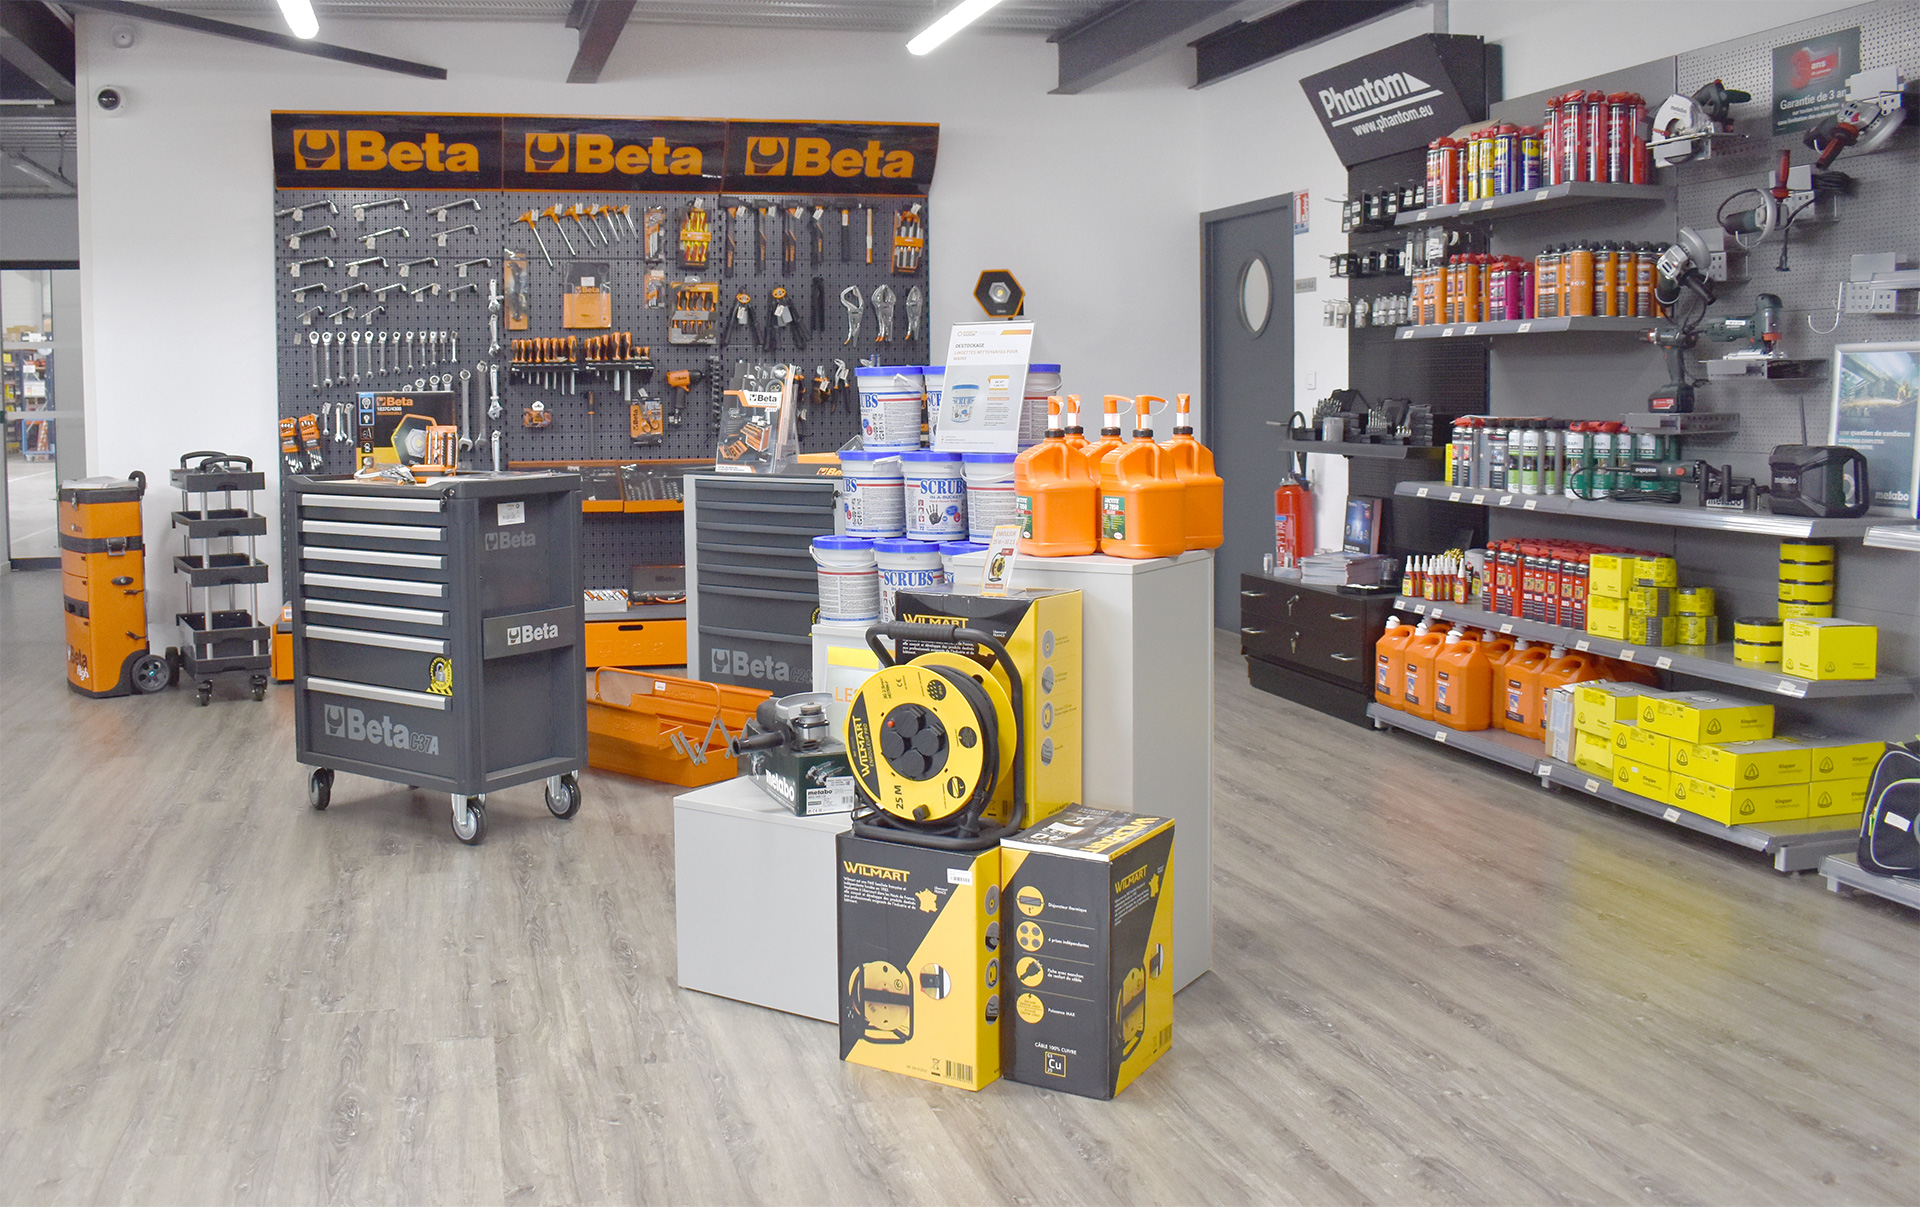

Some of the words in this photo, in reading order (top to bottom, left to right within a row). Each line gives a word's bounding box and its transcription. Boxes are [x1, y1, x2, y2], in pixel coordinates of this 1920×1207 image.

[1811, 60, 1826, 70] ans
[1318, 72, 1408, 119] Phantom
[1780, 94, 1815, 110] Garantie
[1816, 92, 1828, 102] de
[1829, 90, 1835, 100] 3
[1836, 88, 1847, 98] an
[1352, 105, 1434, 136] www.phantom.eu
[346, 130, 479, 172] Beta
[576, 134, 703, 175] Beta
[792, 137, 914, 178] Beta
[387, 396, 414, 406] Beta
[758, 394, 778, 402] Beta
[860, 394, 878, 408] UBS
[1882, 430, 1911, 438] confiance
[828, 468, 843, 476] Be
[1774, 476, 1796, 484] metabo
[1875, 490, 1910, 501] metabo
[500, 530, 536, 548] Beta
[884, 571, 934, 586] SCRUBS
[522, 622, 558, 643] Beta
[70, 648, 88, 668] Beta
[732, 650, 790, 682] Beta
[347, 708, 410, 750] Beta
[852, 716, 870, 778] WILMART
[865, 735, 874, 767] ENROULEUR
[766, 769, 795, 802] metabo
[894, 785, 902, 795] M
[896, 797, 904, 810] 25
[843, 860, 910, 882] WILMART
[1115, 864, 1148, 894] WILMART
[1068, 904, 1087, 913] thermique
[1034, 1041, 1048, 1049] CÂBLE
[1048, 1059, 1062, 1070] Cu
